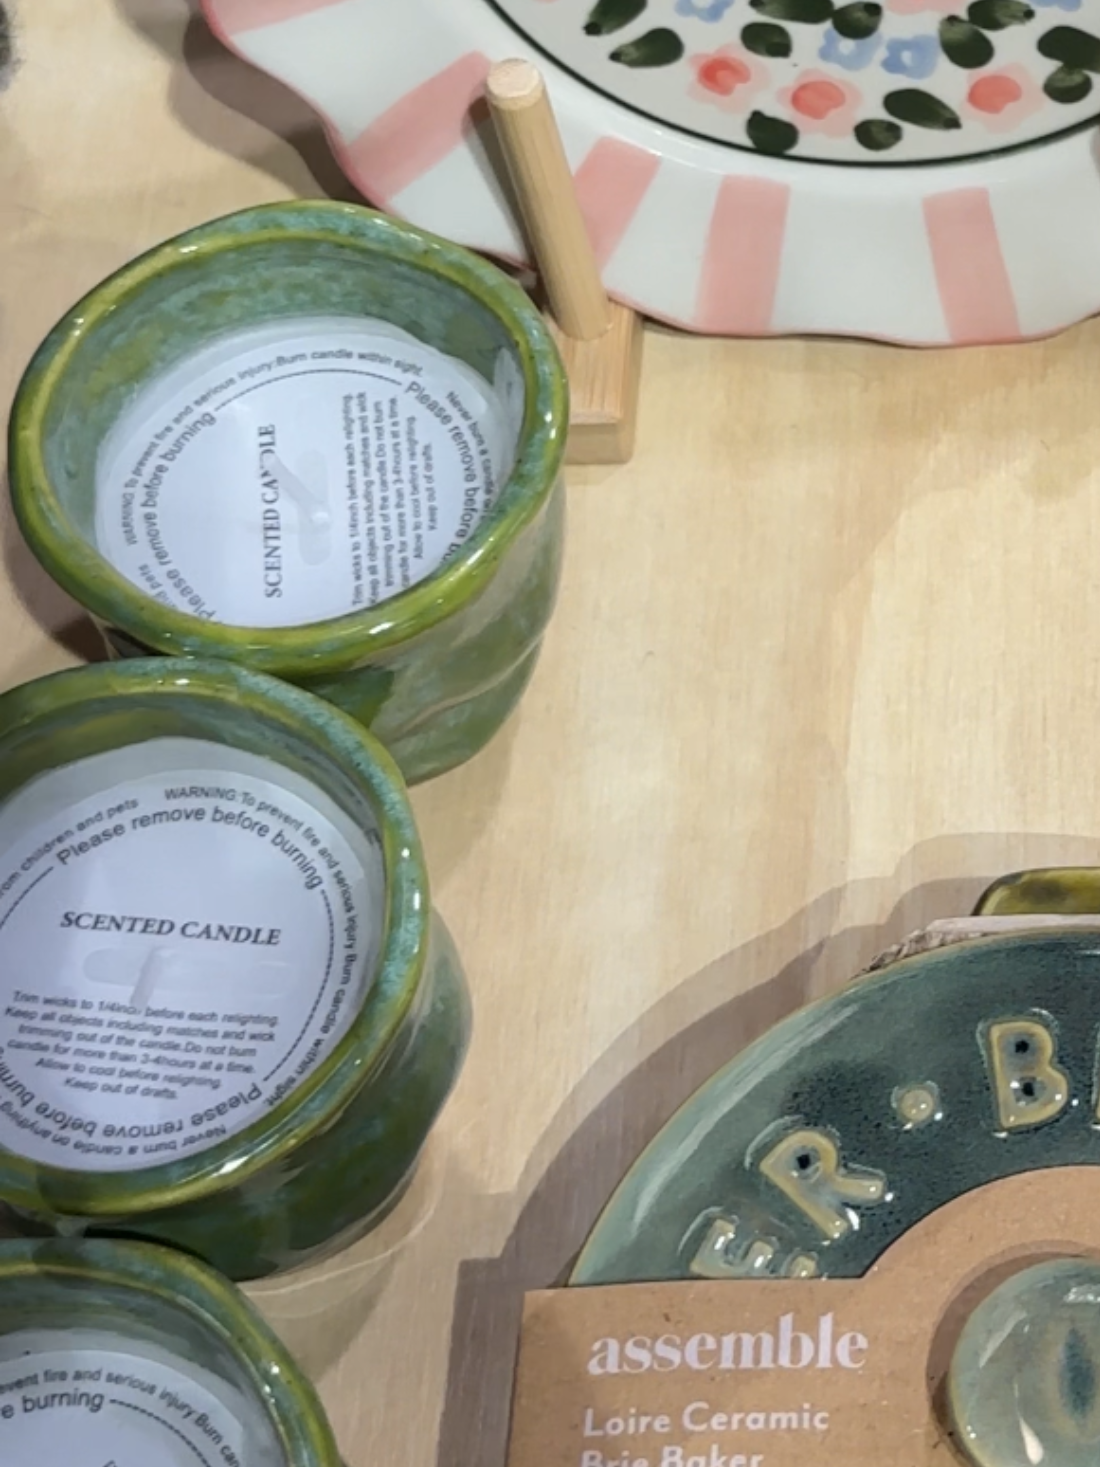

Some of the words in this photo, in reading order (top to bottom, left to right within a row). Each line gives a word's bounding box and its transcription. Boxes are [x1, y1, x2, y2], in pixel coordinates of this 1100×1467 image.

[172, 405, 194, 424] and
[193, 377, 237, 406] serious
[310, 348, 353, 360] candle
[357, 351, 393, 365] within
[404, 381, 453, 426] Please
[446, 391, 473, 421] Never
[158, 412, 216, 462] burning
[357, 414, 370, 434] and
[344, 442, 356, 467] each
[448, 426, 477, 482] remove
[140, 463, 169, 509] before
[346, 468, 359, 502] before
[409, 464, 421, 497] before
[363, 479, 376, 524] including
[394, 486, 406, 510] than
[410, 498, 422, 519] cool
[455, 486, 481, 539] before
[396, 511, 406, 538] more
[427, 504, 439, 532] Keep
[143, 511, 172, 566] remove
[262, 508, 283, 599] SCENTED
[256, 801, 304, 831] prevent
[20, 829, 75, 871] children
[75, 811, 104, 832] and
[105, 798, 140, 819] pets
[56, 823, 126, 865] Please
[131, 806, 206, 830] remove
[211, 805, 270, 838] before
[270, 828, 323, 891] burning
[301, 826, 321, 848] fire
[318, 847, 340, 869] and
[333, 869, 355, 913] serious
[60, 911, 175, 935] SCENTED
[180, 921, 282, 945] CANDLE
[5, 1006, 39, 1020] Keep
[58, 1014, 104, 1028] objects
[106, 1020, 163, 1036] including
[166, 1026, 219, 1039] matches
[221, 1029, 246, 1040] and
[248, 1031, 275, 1042] wick
[42, 997, 77, 1008] wicks
[98, 1000, 142, 1015] 1/4inc
[144, 1006, 185, 1021] before
[187, 1012, 218, 1022] each
[320, 988, 346, 1034] candle
[7, 1038, 50, 1052] candle
[53, 1043, 72, 1054] for
[72, 1048, 107, 1060] more
[109, 1050, 138, 1063] than
[18, 1023, 73, 1042] trimming
[76, 1032, 98, 1042] out
[115, 1035, 136, 1047] the
[205, 1046, 227, 1055] not
[228, 1045, 257, 1057] burn
[35, 1057, 70, 1071] Allow
[88, 1065, 117, 1077] cool
[119, 1067, 160, 1082] before
[295, 1038, 325, 1076] within
[64, 1076, 99, 1093] Keep
[100, 1083, 123, 1093] out
[35, 1101, 98, 1139] before
[191, 1082, 262, 1126] Please
[51, 1133, 71, 1146] on
[103, 1119, 183, 1139] remove
[182, 1124, 228, 1147] Never
[73, 1139, 124, 1155] candle
[143, 1140, 177, 1154] burn
[587, 1311, 869, 1375] assemble
[43, 1368, 68, 1383] fire
[72, 1368, 102, 1382] and
[105, 1370, 156, 1395] serious
[21, 1387, 105, 1413] burning
[583, 1407, 671, 1437] Loire
[682, 1401, 830, 1431] Ceramic
[660, 1444, 764, 1467] Baker
